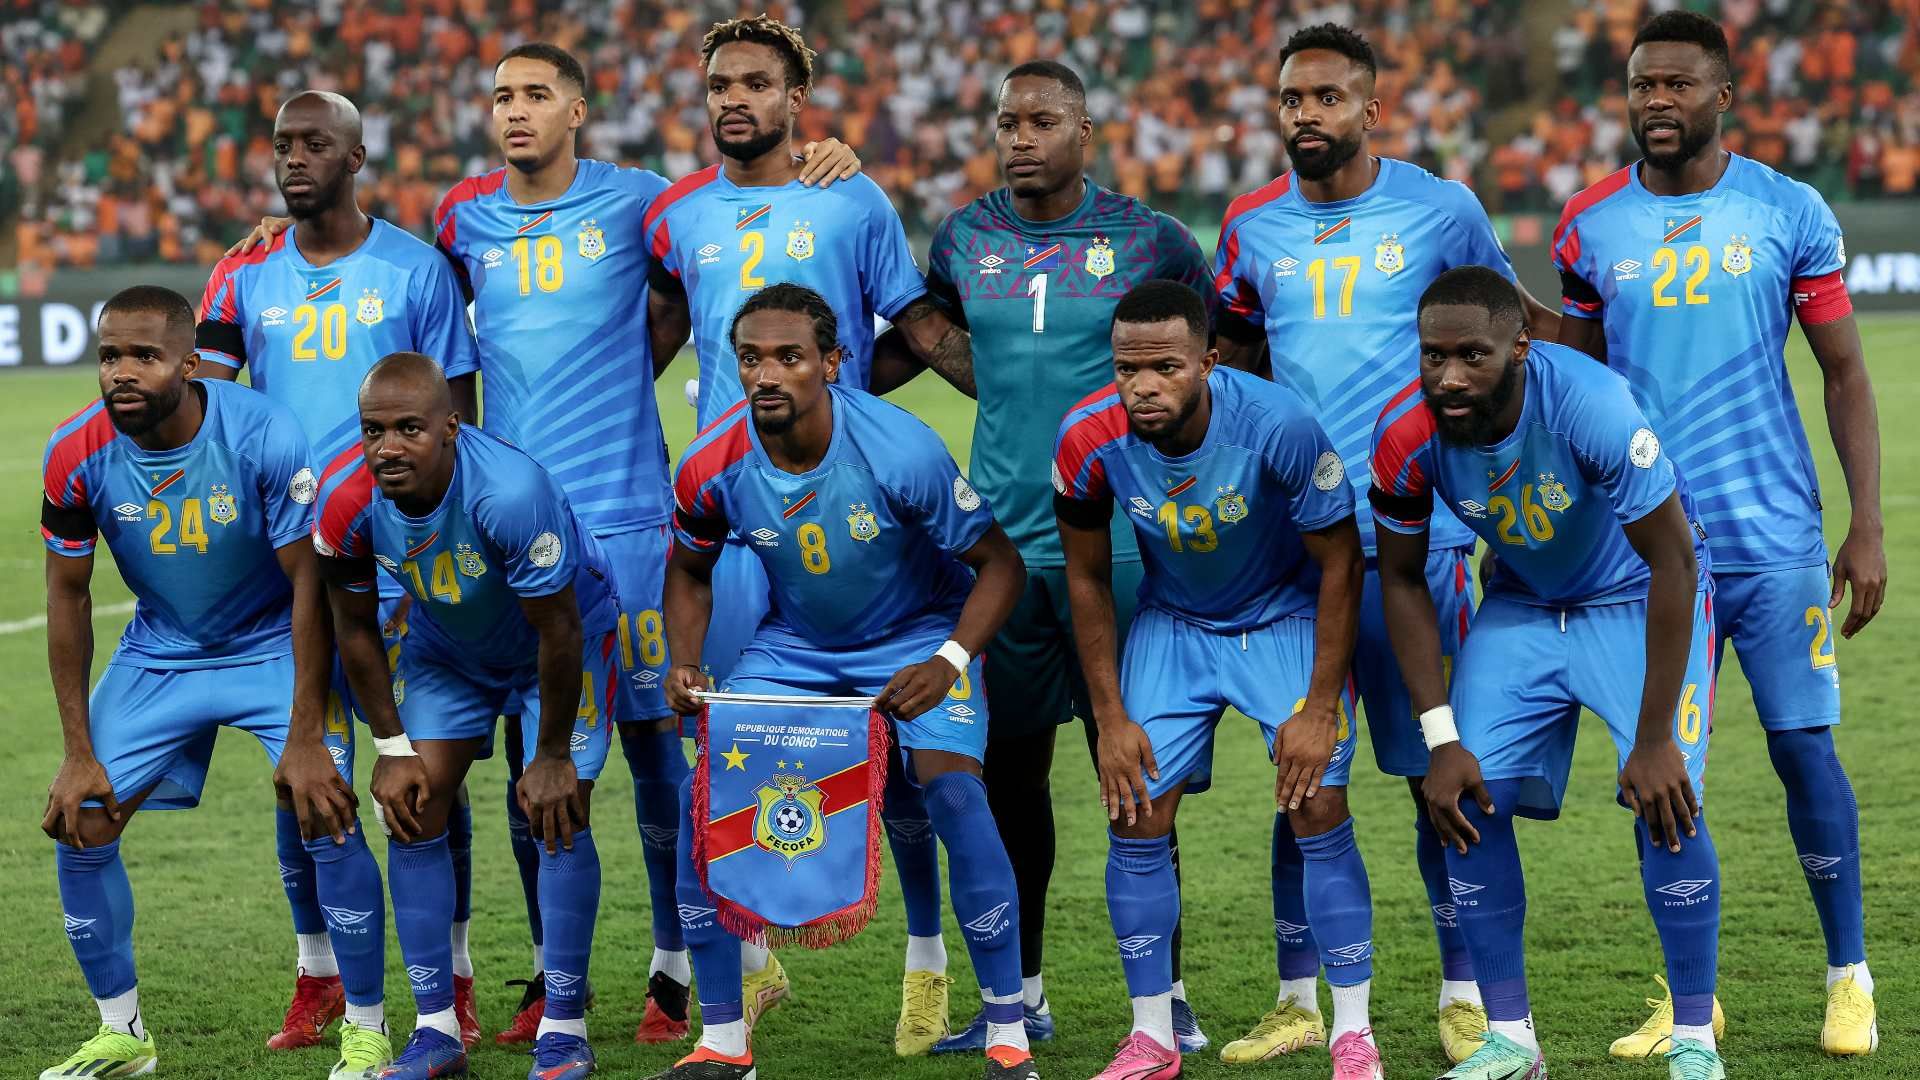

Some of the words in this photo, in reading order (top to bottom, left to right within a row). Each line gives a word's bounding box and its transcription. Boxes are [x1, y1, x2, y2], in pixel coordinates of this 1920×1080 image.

[484, 260, 503, 269] umbro
[511, 235, 564, 295] 18
[700, 256, 720, 264] umbro
[740, 231, 765, 290] 2
[979, 267, 1001, 275] umbro
[1615, 273, 1640, 281] umbro
[1651, 245, 1710, 307] 22
[1306, 255, 1361, 320] 17
[1028, 273, 1048, 333] 1
[262, 319, 285, 327] umbro
[291, 303, 347, 361] 20
[1131, 507, 1152, 519] umbro
[1463, 510, 1486, 519] umbro
[1487, 484, 1554, 546] 26
[146, 498, 209, 555] 24
[1157, 501, 1219, 552] 13
[755, 539, 779, 547] umbro
[797, 522, 831, 574] 8
[402, 550, 462, 604] 14
[618, 610, 666, 671] 18
[1805, 606, 1836, 670] 2
[949, 715, 974, 725] umbro
[1678, 683, 1701, 745] 6
[735, 724, 786, 734] REPUBLIQUE
[787, 727, 849, 737] DEMOCRATIQUE
[763, 734, 779, 746] DU
[781, 736, 818, 748] CONGO
[766, 834, 815, 852] FECOFA
[1452, 896, 1478, 906] bro
[1664, 894, 1709, 906] umbro
[327, 919, 368, 934] umbro
[680, 920, 713, 930] mbro
[973, 919, 1010, 942] umbro
[1436, 919, 1457, 928] umb
[67, 931, 91, 940] bro
[1275, 934, 1303, 943] mbro
